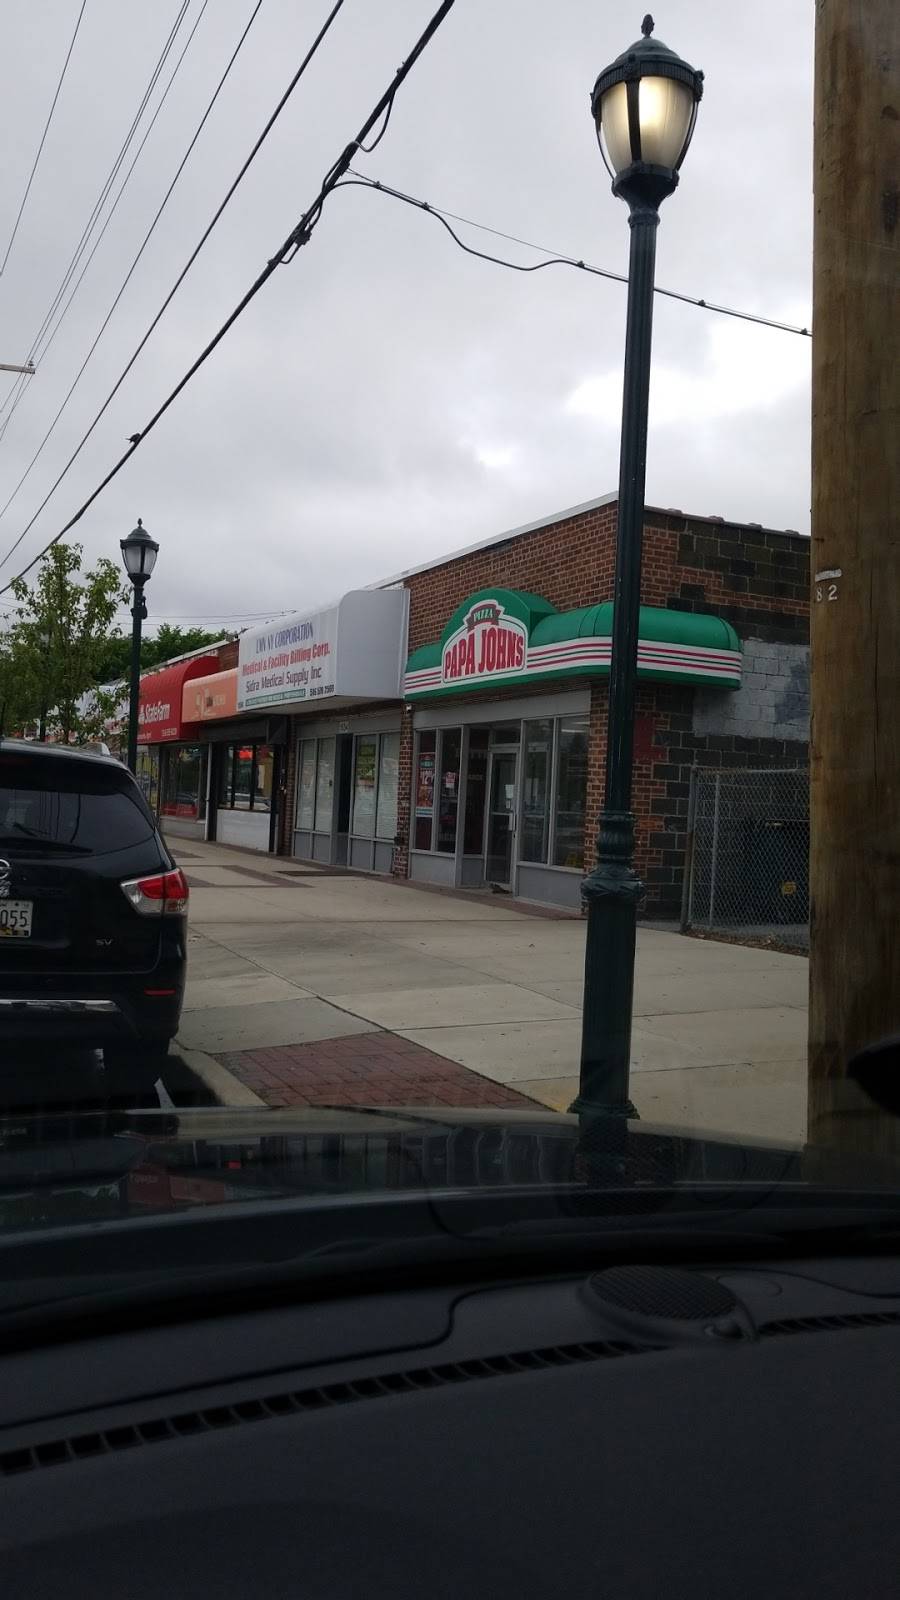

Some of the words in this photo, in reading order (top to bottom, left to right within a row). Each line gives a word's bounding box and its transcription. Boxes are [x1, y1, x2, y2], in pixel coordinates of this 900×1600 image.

[473, 608, 493, 622] PIZZA
[274, 622, 314, 649] CORPORATION
[242, 660, 263, 676] Medical
[268, 653, 290, 670] Facility
[290, 647, 311, 664] Billing
[312, 642, 331, 659] Corp.
[444, 632, 476, 680] PAPA
[478, 627, 524, 673] JOHN'S
[261, 672, 285, 689] Medical
[286, 668, 309, 687] Supply
[311, 666, 322, 680] Inc
